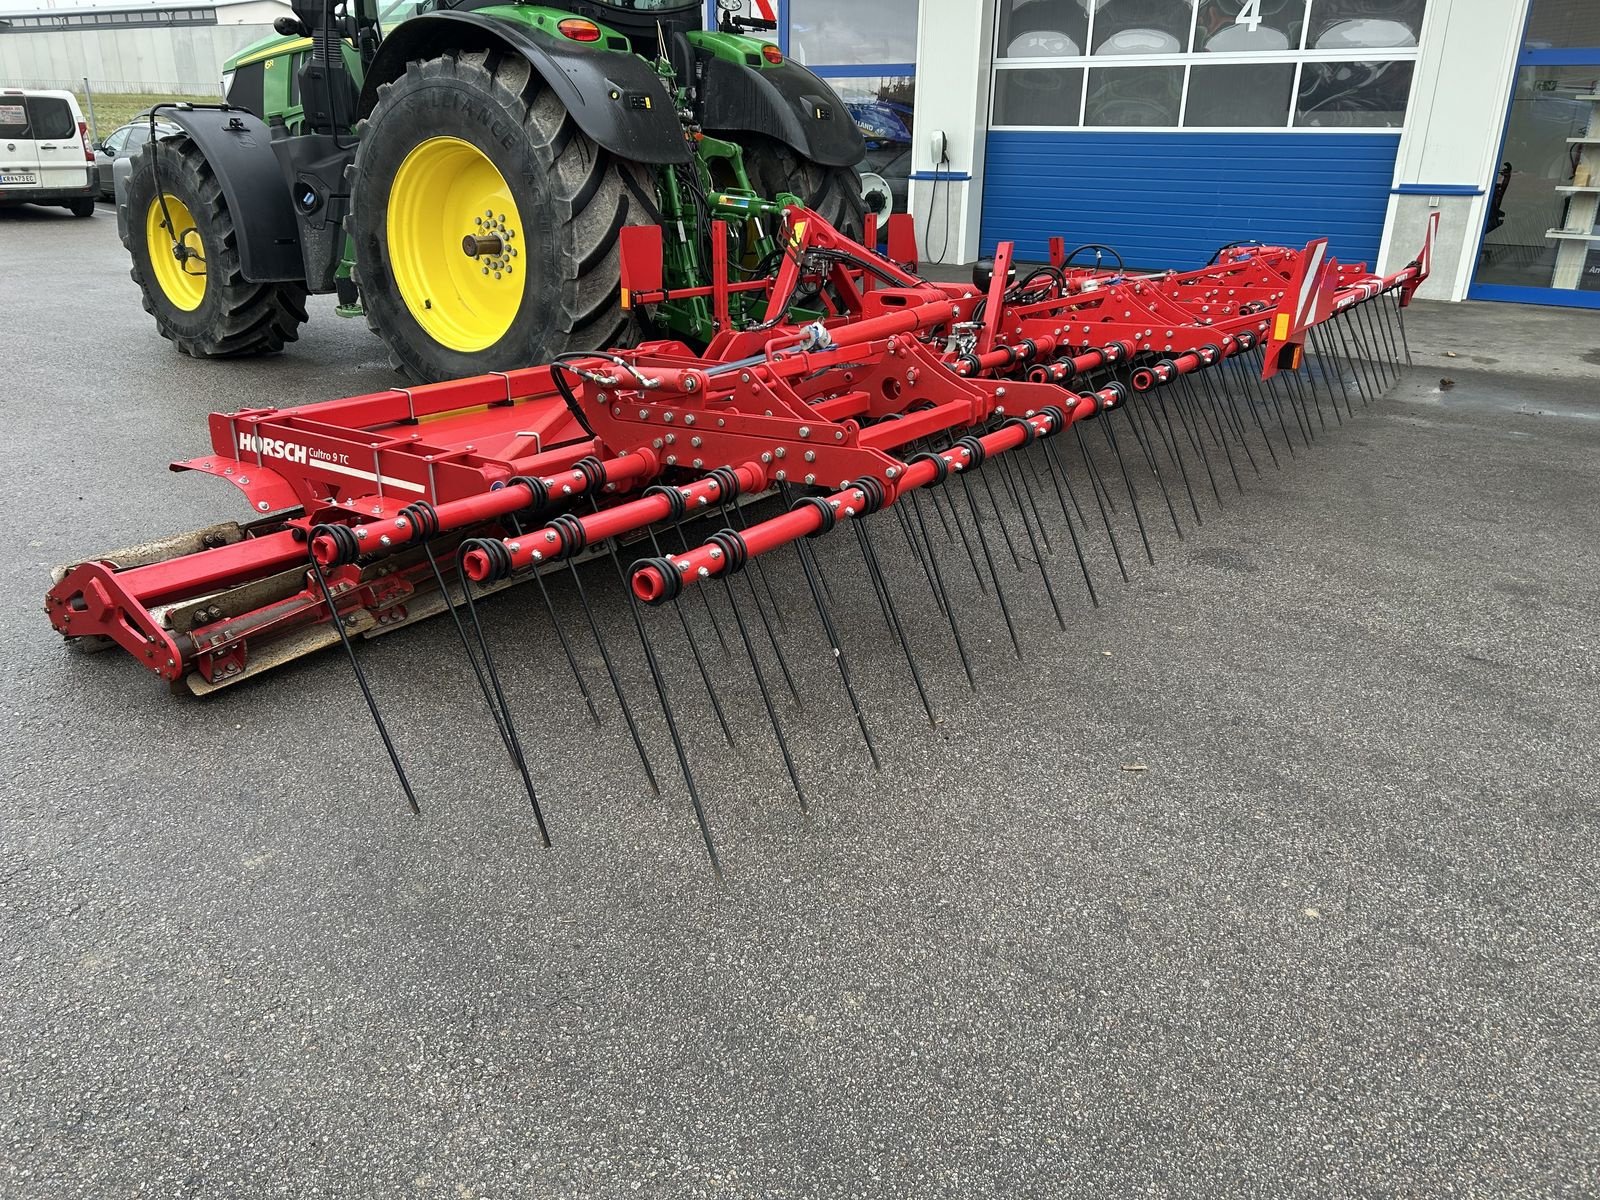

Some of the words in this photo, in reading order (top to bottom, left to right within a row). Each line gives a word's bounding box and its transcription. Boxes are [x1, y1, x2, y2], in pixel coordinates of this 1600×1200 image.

[1235, 0, 1263, 32] 4
[239, 431, 307, 465] HORSCH
[309, 447, 331, 462] Cultro
[332, 452, 338, 462] 9
[339, 453, 350, 465] TC
